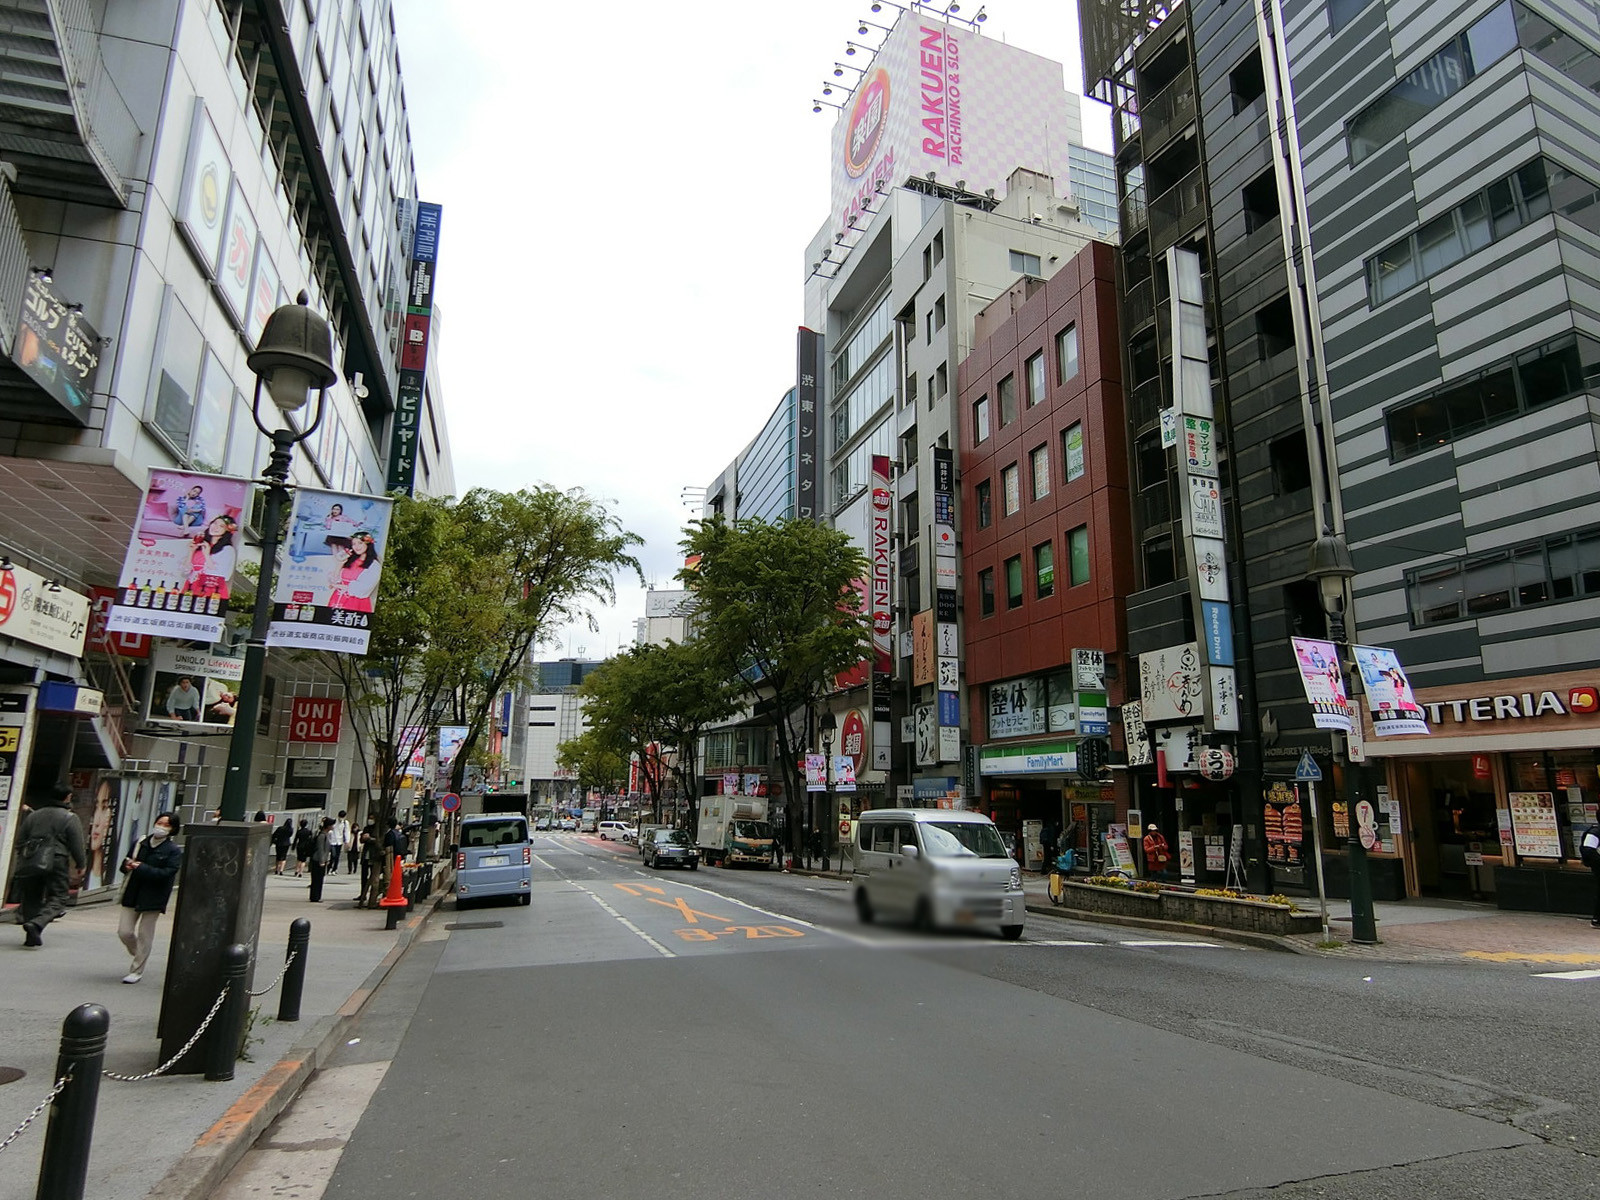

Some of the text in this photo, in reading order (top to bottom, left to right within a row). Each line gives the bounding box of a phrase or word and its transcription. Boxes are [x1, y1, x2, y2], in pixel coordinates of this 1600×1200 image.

[947, 35, 959, 71] SLOT
[920, 26, 946, 158] RAKUEN
[949, 85, 962, 165] PACHINKO
[416, 210, 438, 260] THE PRIME
[874, 516, 888, 606] RAKUEN
[70, 621, 84, 640] 2F
[175, 654, 242, 669] UNIQLO LifeWear
[1078, 650, 1102, 666] 整体
[991, 682, 1028, 717] 整体
[297, 702, 335, 719] UNI
[1080, 710, 1105, 718] FamilyMart
[295, 721, 334, 739] QLO
[991, 714, 1029, 728] フットセラピー
[918, 707, 929, 762] かいり
[1027, 755, 1064, 770] FamilyMart
